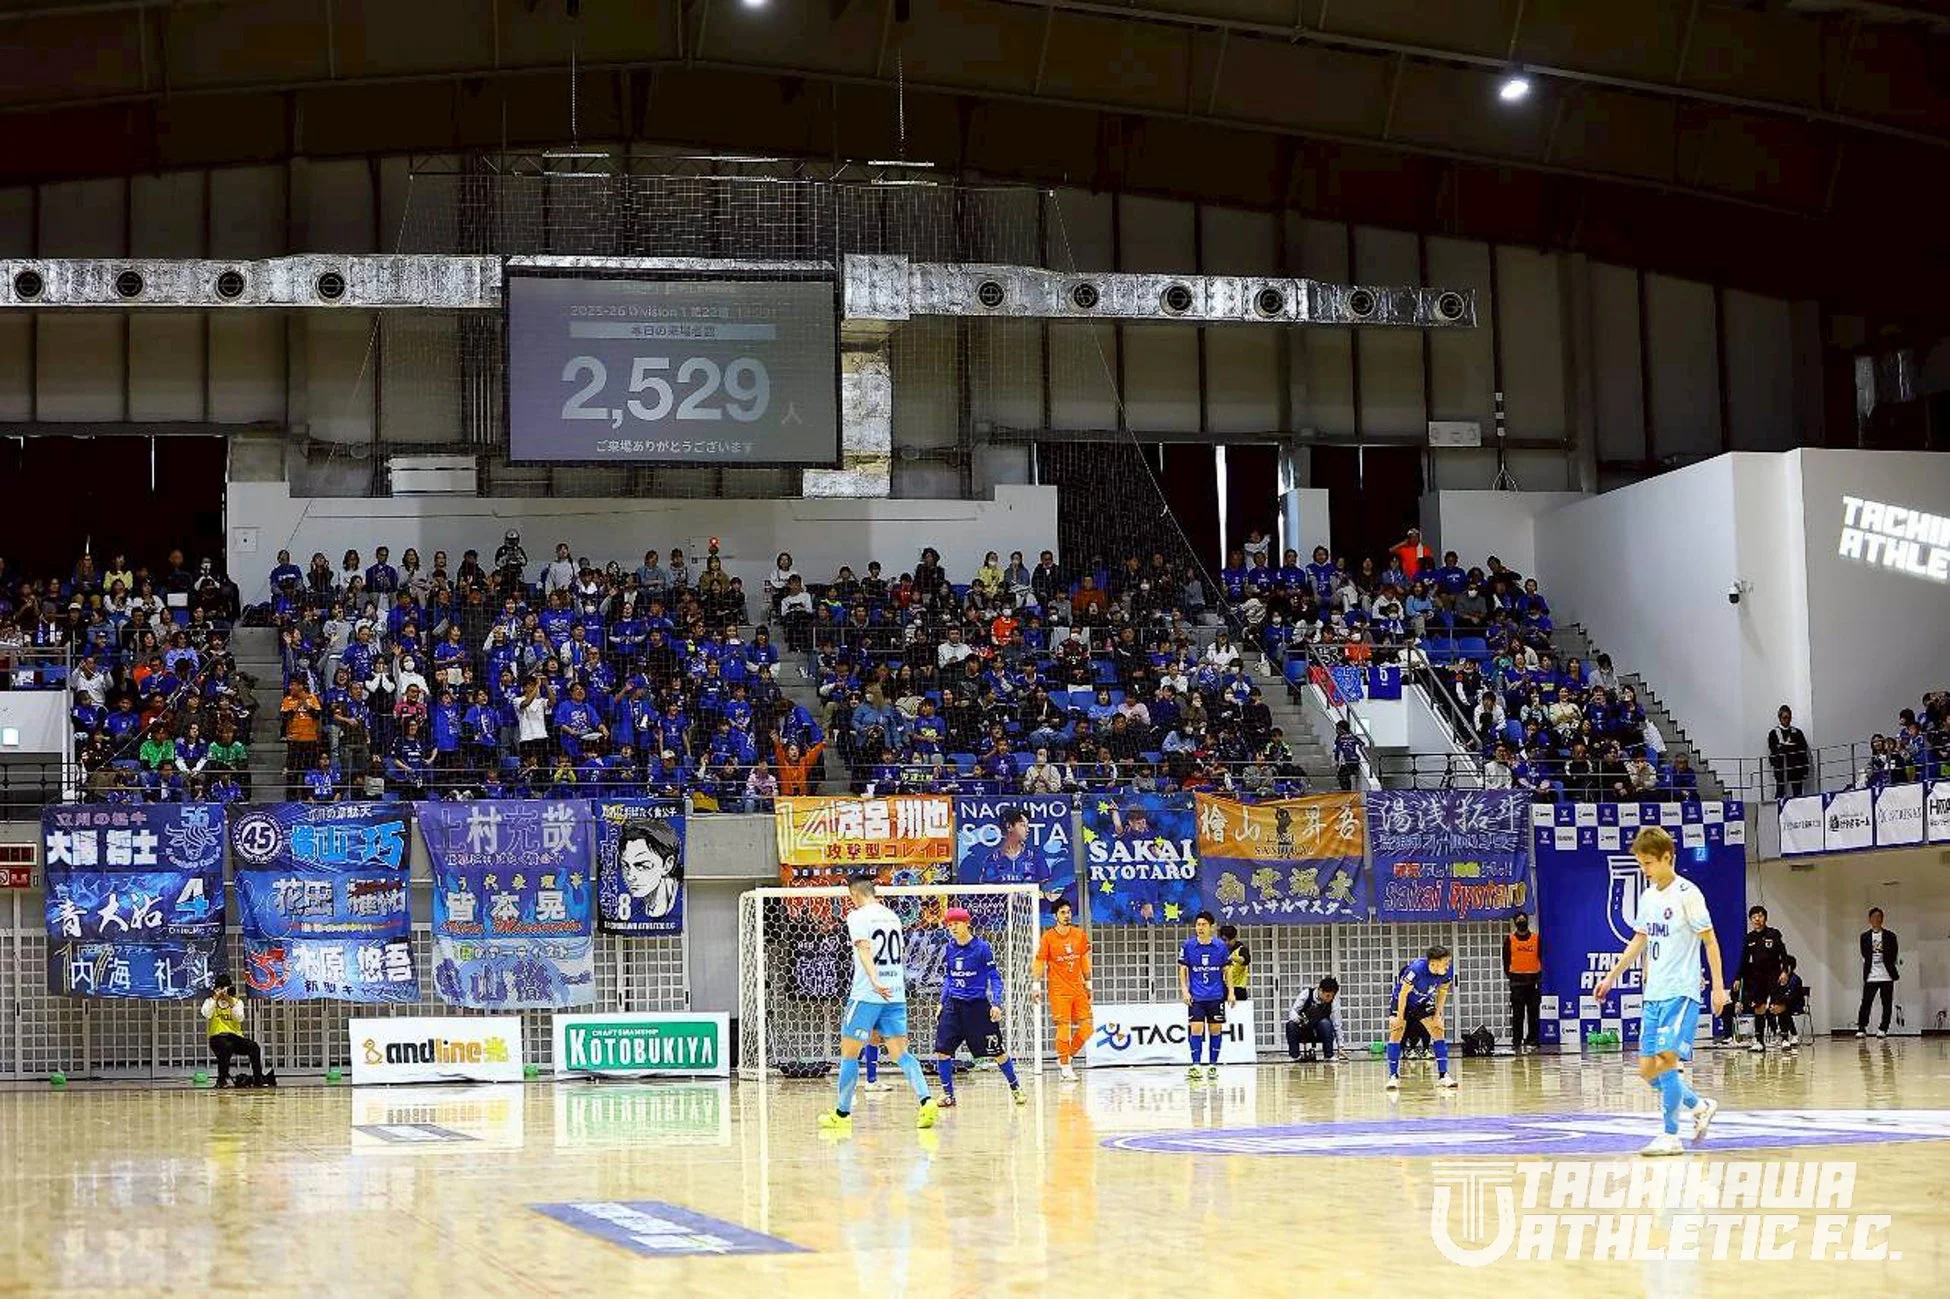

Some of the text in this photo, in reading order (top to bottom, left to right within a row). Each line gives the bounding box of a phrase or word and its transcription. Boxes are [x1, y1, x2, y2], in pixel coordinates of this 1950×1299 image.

[561, 356, 802, 429] 2,529 人
[596, 440, 753, 454] ご来場ありがとうございます
[1839, 527, 1950, 582] ATHLE
[243, 827, 272, 851] 45
[827, 843, 950, 861] 攻撃型コレイロ
[1089, 839, 1193, 862] SAKAI
[1090, 864, 1196, 880] RYOTARO
[175, 878, 209, 916] 4
[872, 929, 900, 965] 20
[1202, 972, 1209, 984] 5
[386, 1037, 482, 1065] andline
[569, 1027, 714, 1067] KOTOBUKIYA
